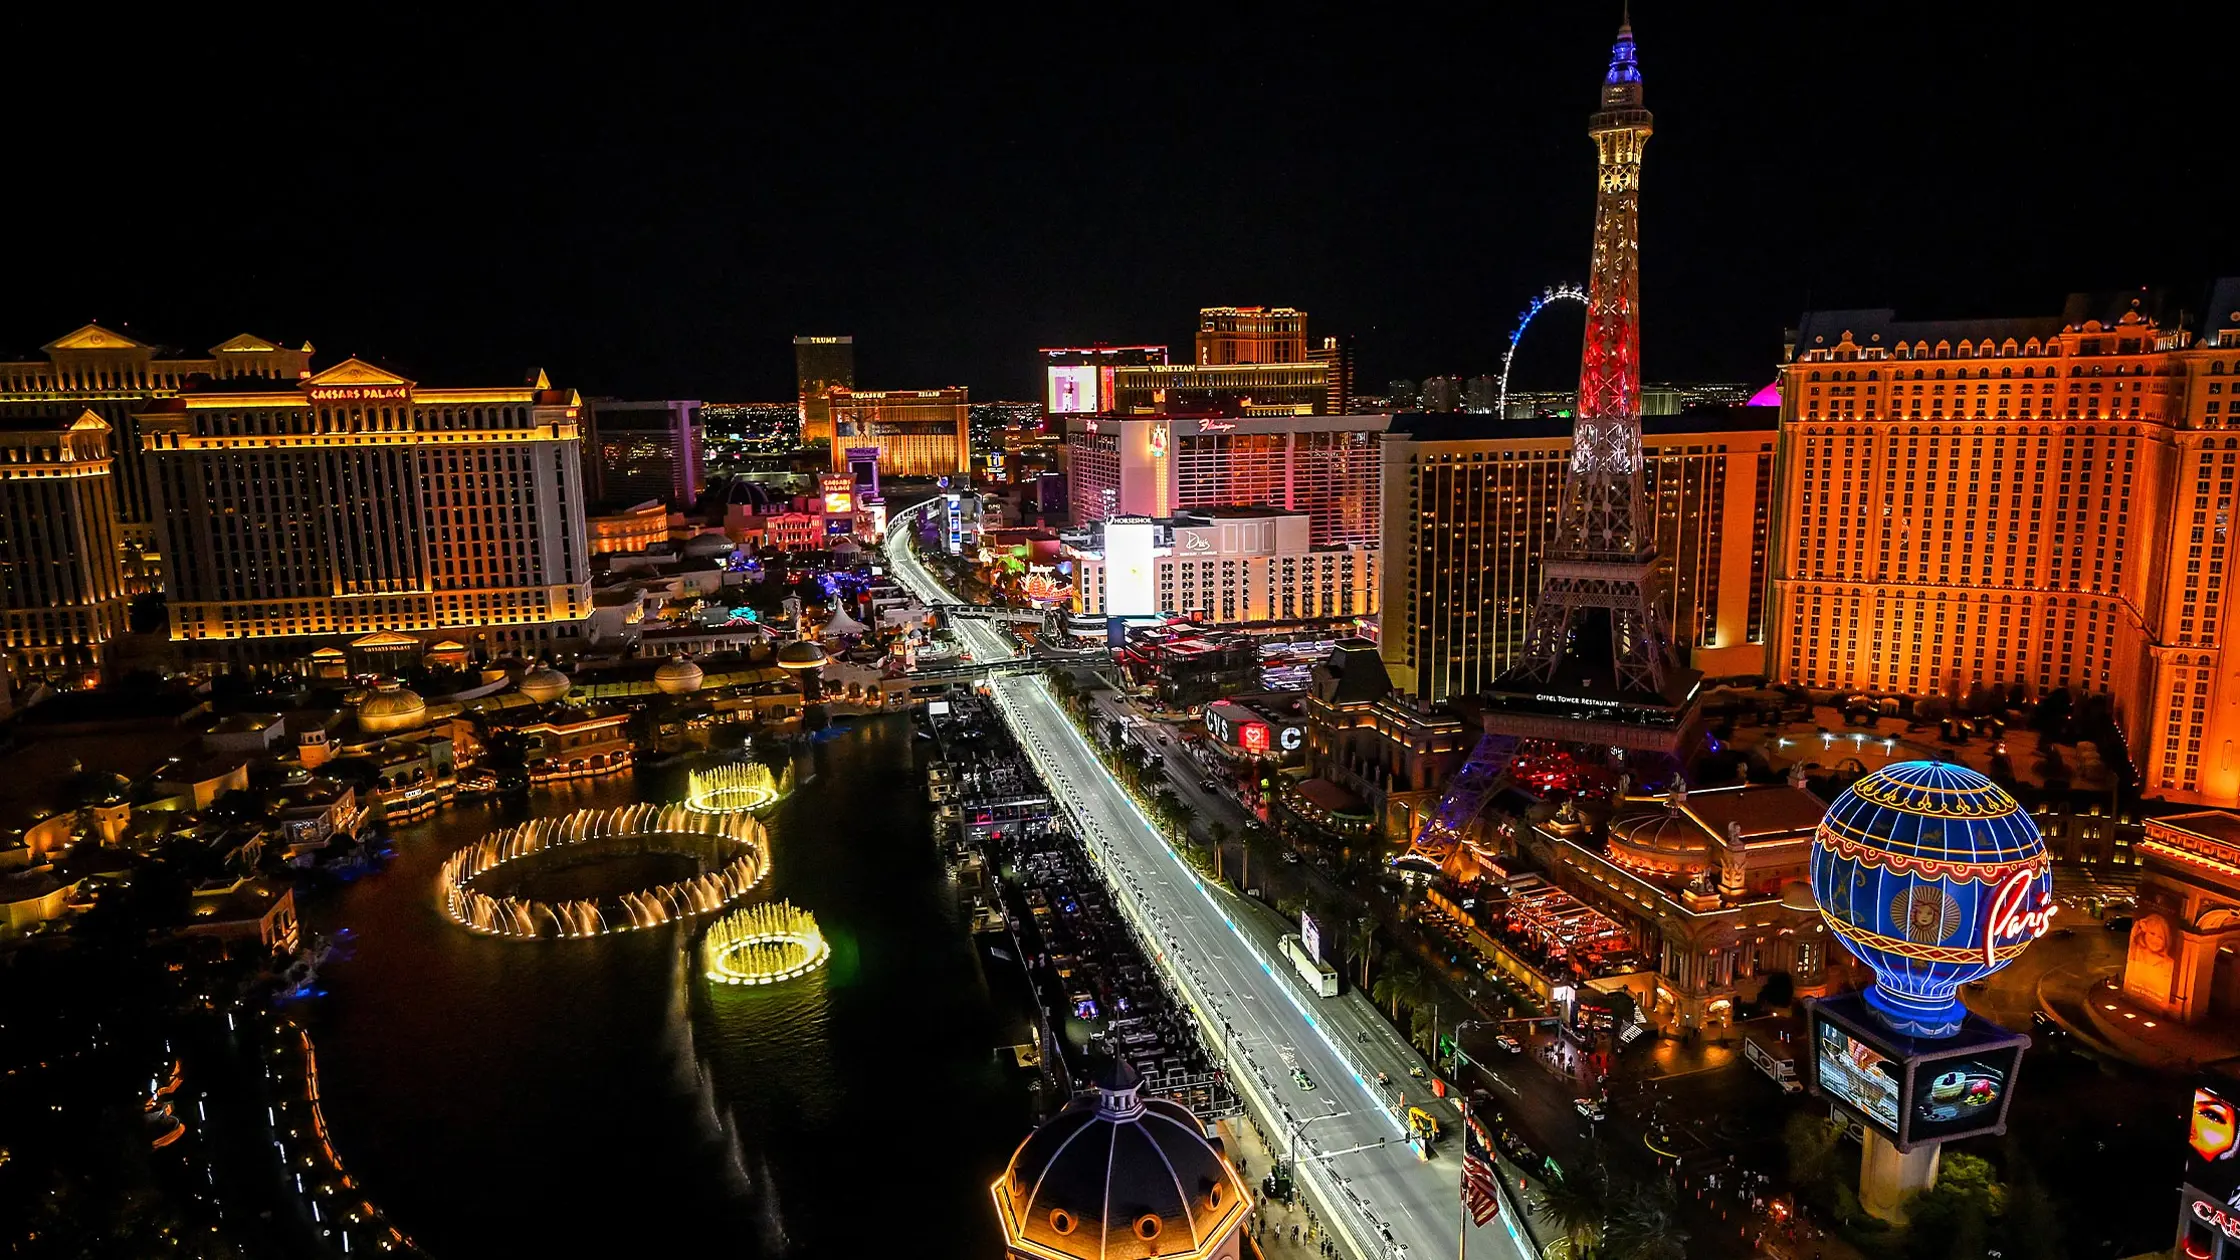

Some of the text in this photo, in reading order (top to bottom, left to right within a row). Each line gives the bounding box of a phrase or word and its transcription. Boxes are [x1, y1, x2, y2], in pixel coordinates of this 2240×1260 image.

[1150, 364, 1196, 373] VENETIAN
[310, 387, 407, 400] CAESARS PALACE
[1557, 695, 1580, 704] TOWER
[1581, 698, 1620, 708] RESTAURANT
[1206, 708, 1229, 742] CVS
[1986, 868, 2059, 968] Paris
